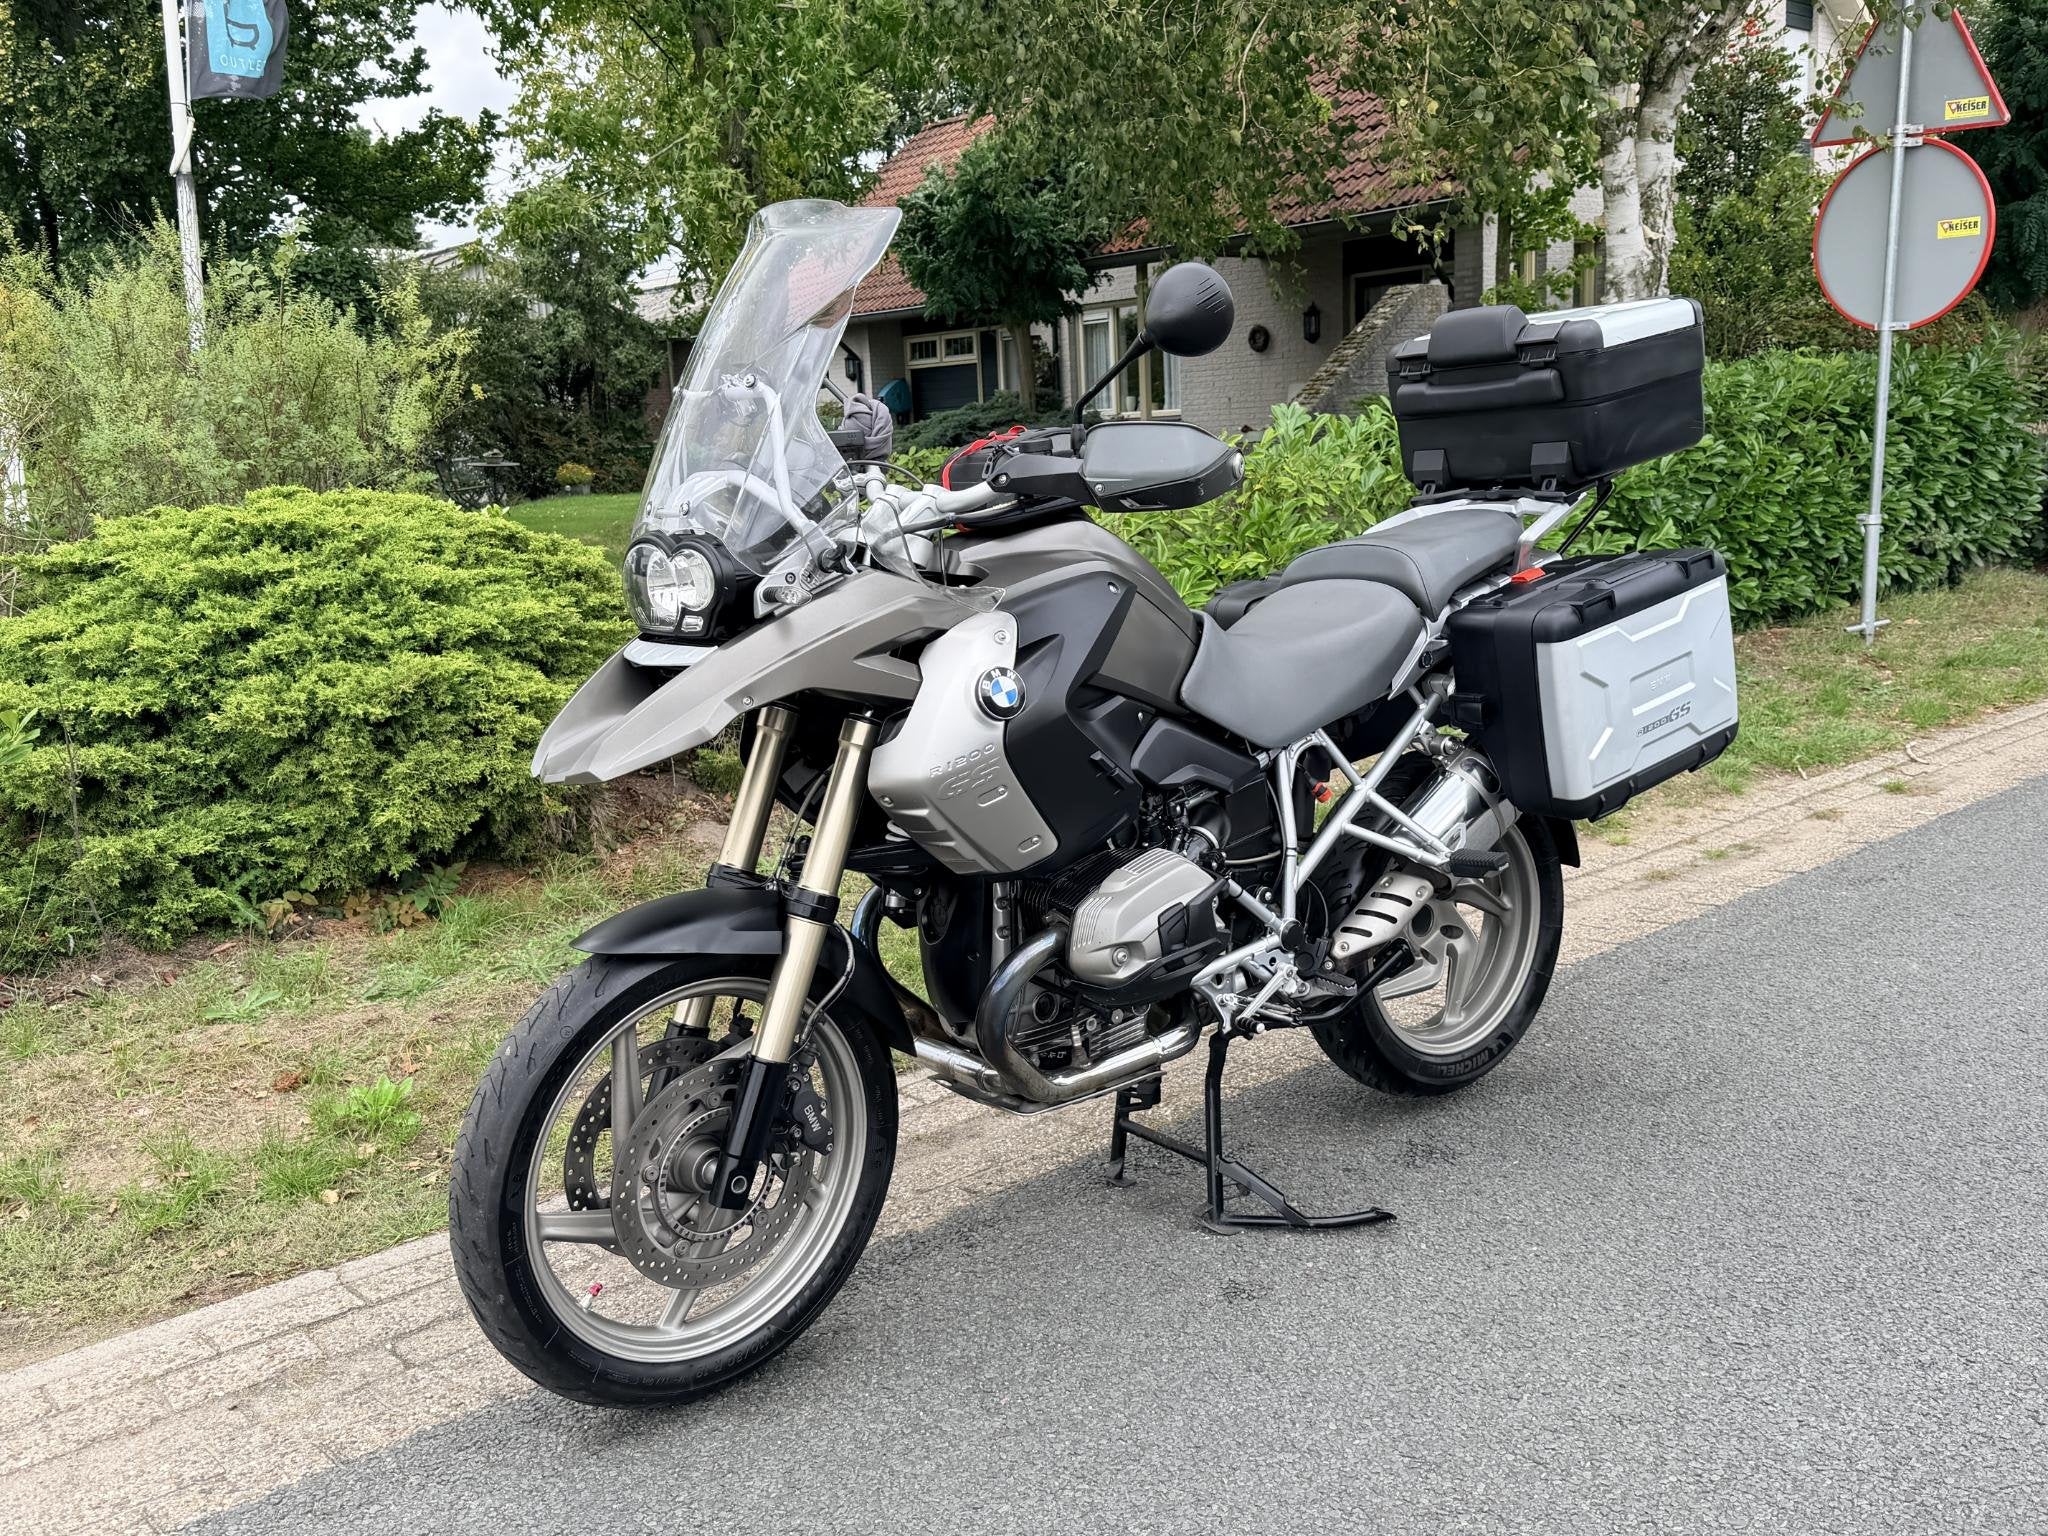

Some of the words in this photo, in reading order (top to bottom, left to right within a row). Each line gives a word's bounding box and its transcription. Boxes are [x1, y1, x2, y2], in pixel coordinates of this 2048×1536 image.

[219, 54, 266, 71] OUTLE
[981, 668, 1017, 690] BMW
[928, 743, 996, 778] R1200
[936, 755, 1001, 800] GS
[1427, 1050, 1490, 1077] MICHELI
[803, 1103, 822, 1133] BMW
